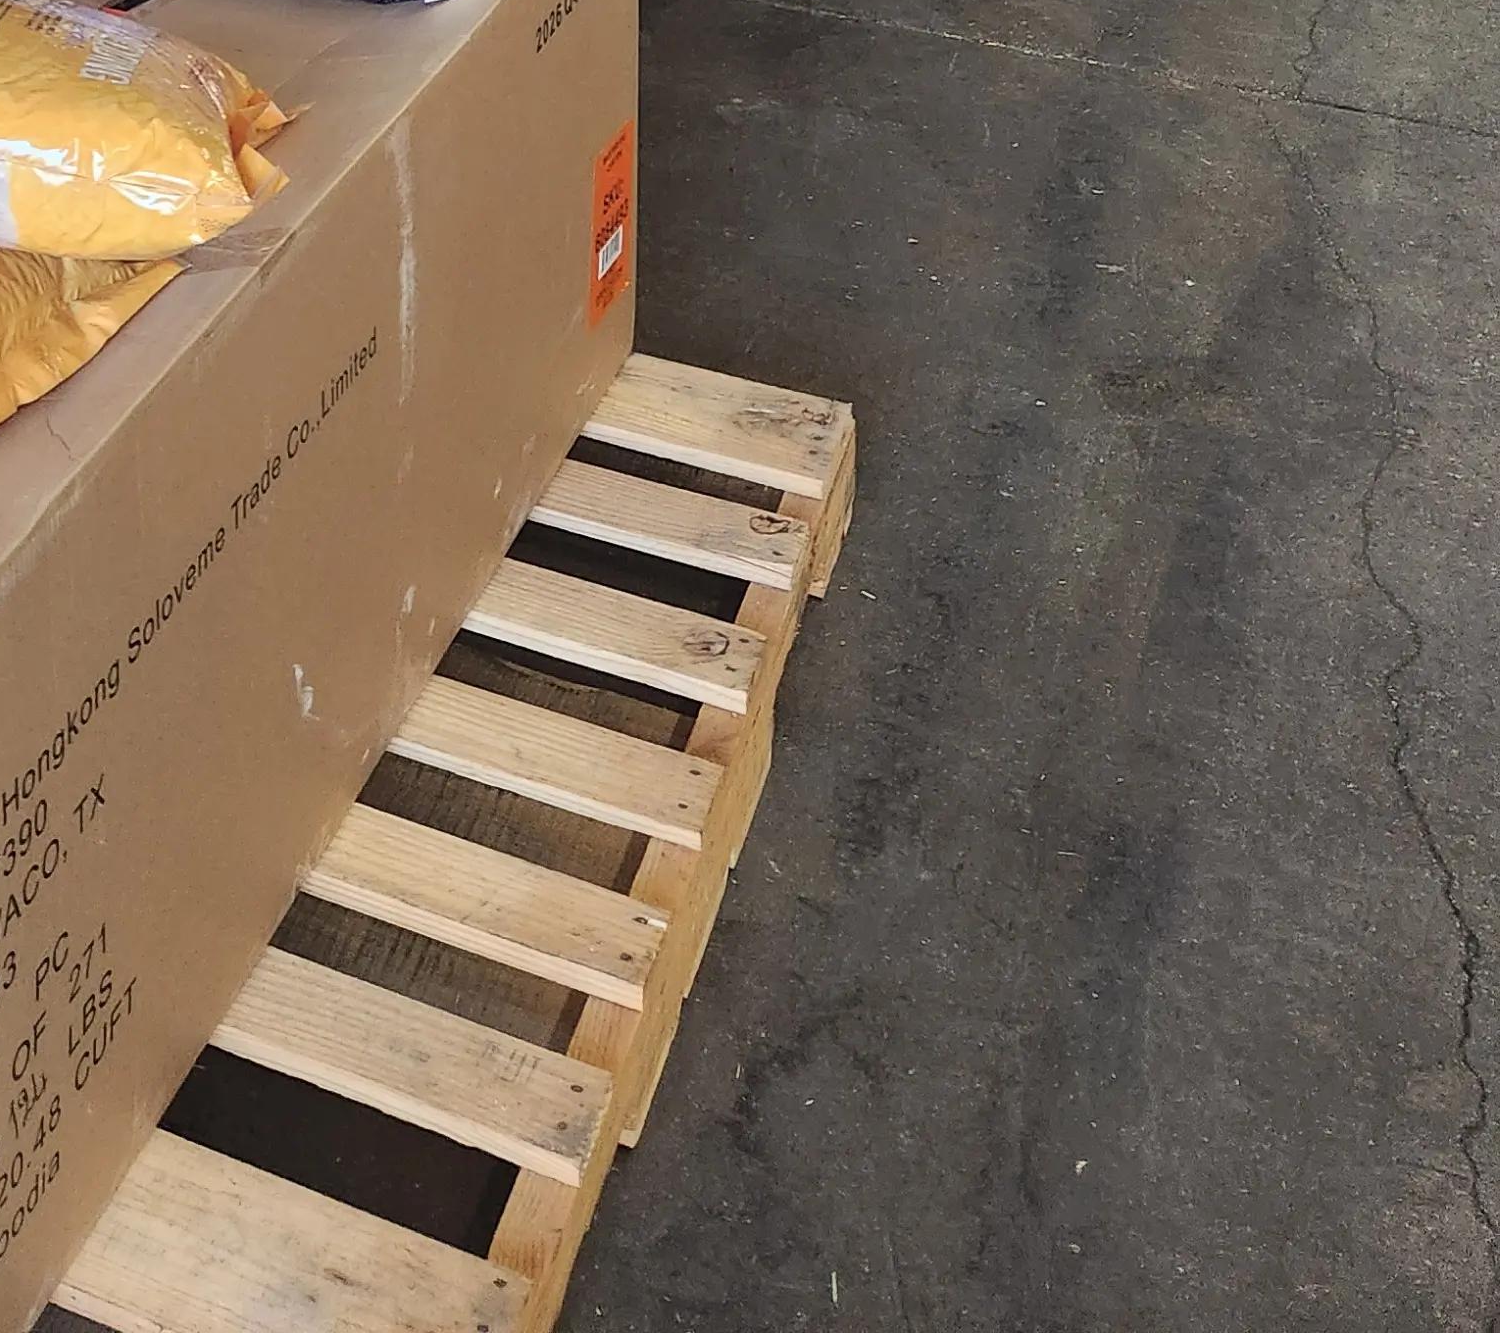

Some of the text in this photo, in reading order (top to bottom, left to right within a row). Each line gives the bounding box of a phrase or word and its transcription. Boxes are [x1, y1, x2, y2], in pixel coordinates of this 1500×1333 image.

[536, 3, 562, 53] 2026
[1, 659, 120, 825] Hongkong
[127, 526, 226, 665] Soloveme
[230, 452, 282, 531] Trade
[73, 774, 106, 833] TX
[10, 1012, 47, 1082] OF
[68, 923, 107, 1003] 271
[34, 931, 70, 1002] PC
[67, 970, 115, 1056] LBS
[73, 977, 138, 1091] CUFT
